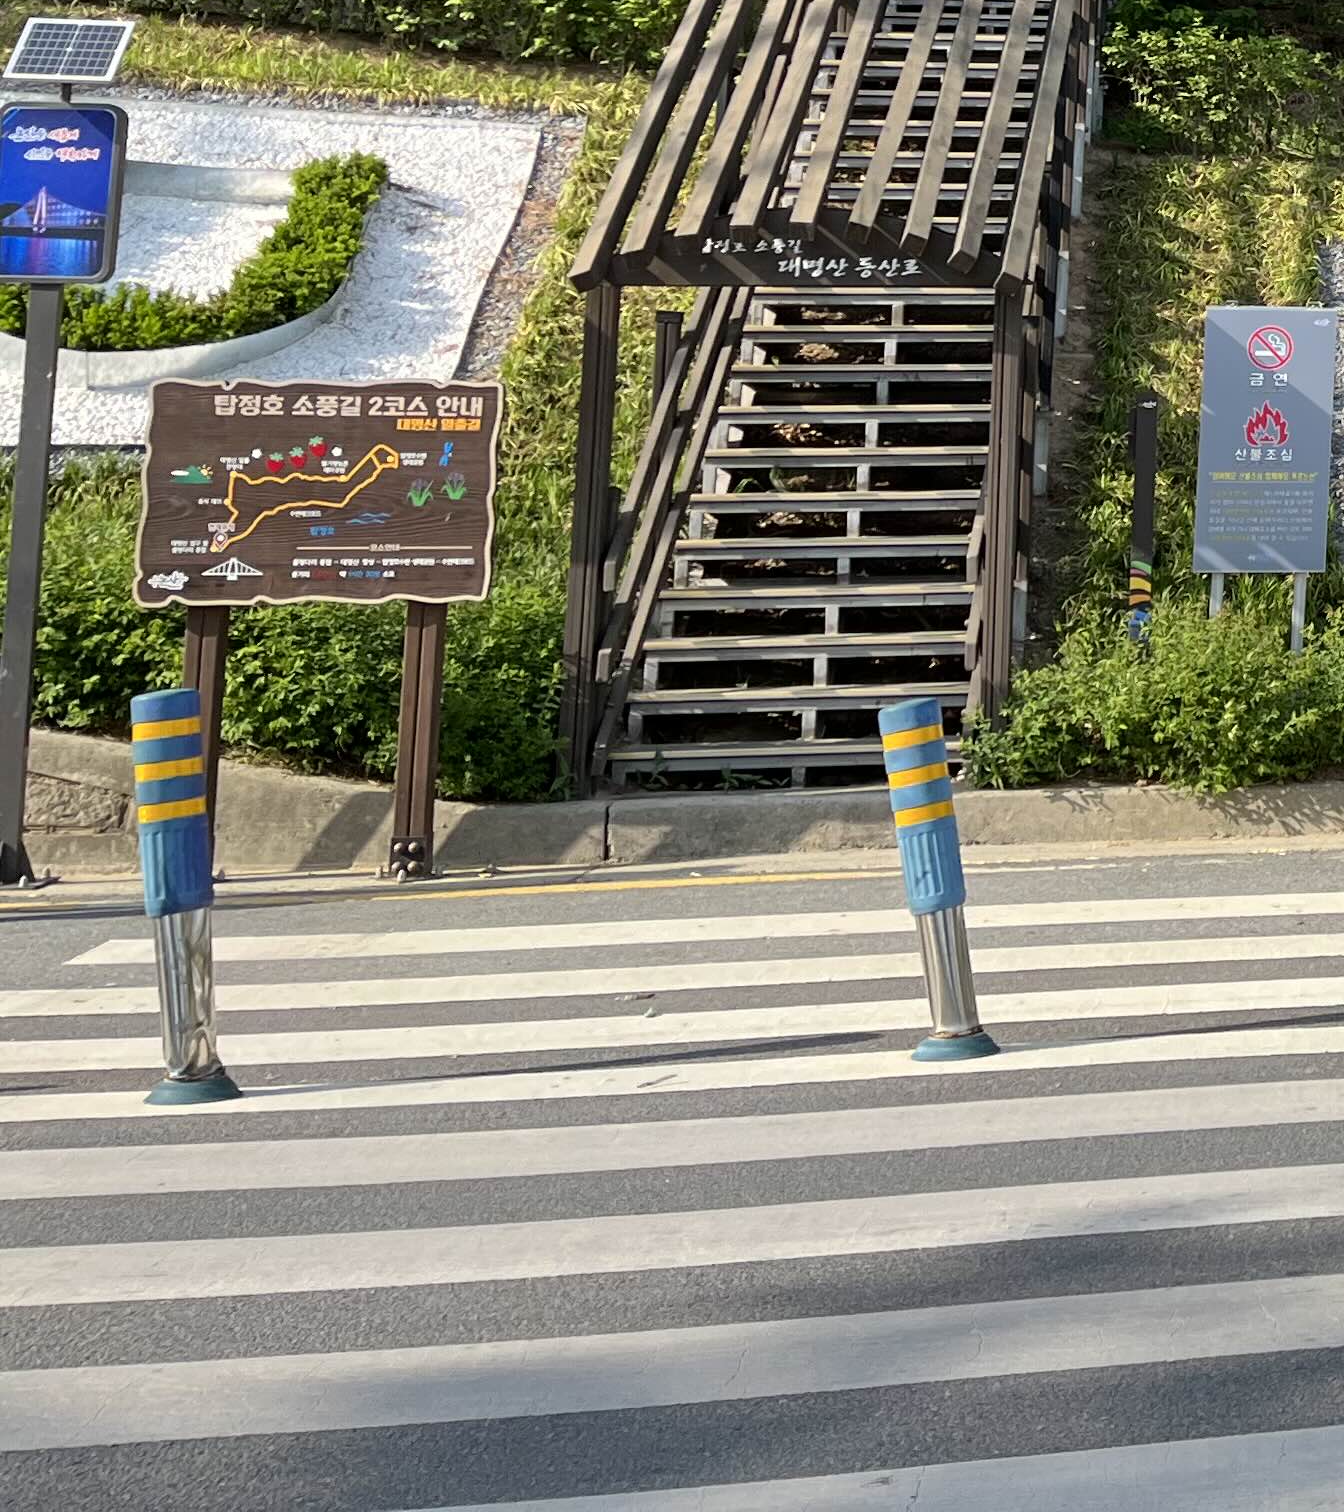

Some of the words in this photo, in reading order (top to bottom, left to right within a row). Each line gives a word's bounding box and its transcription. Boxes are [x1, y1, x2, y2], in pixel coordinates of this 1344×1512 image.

[777, 256, 850, 278] 대명산
[854, 256, 925, 278] 등산로
[213, 394, 285, 417] 탑정호
[291, 394, 362, 418] 소풍길
[368, 396, 429, 418] 2코스
[435, 395, 484, 418] 안내
